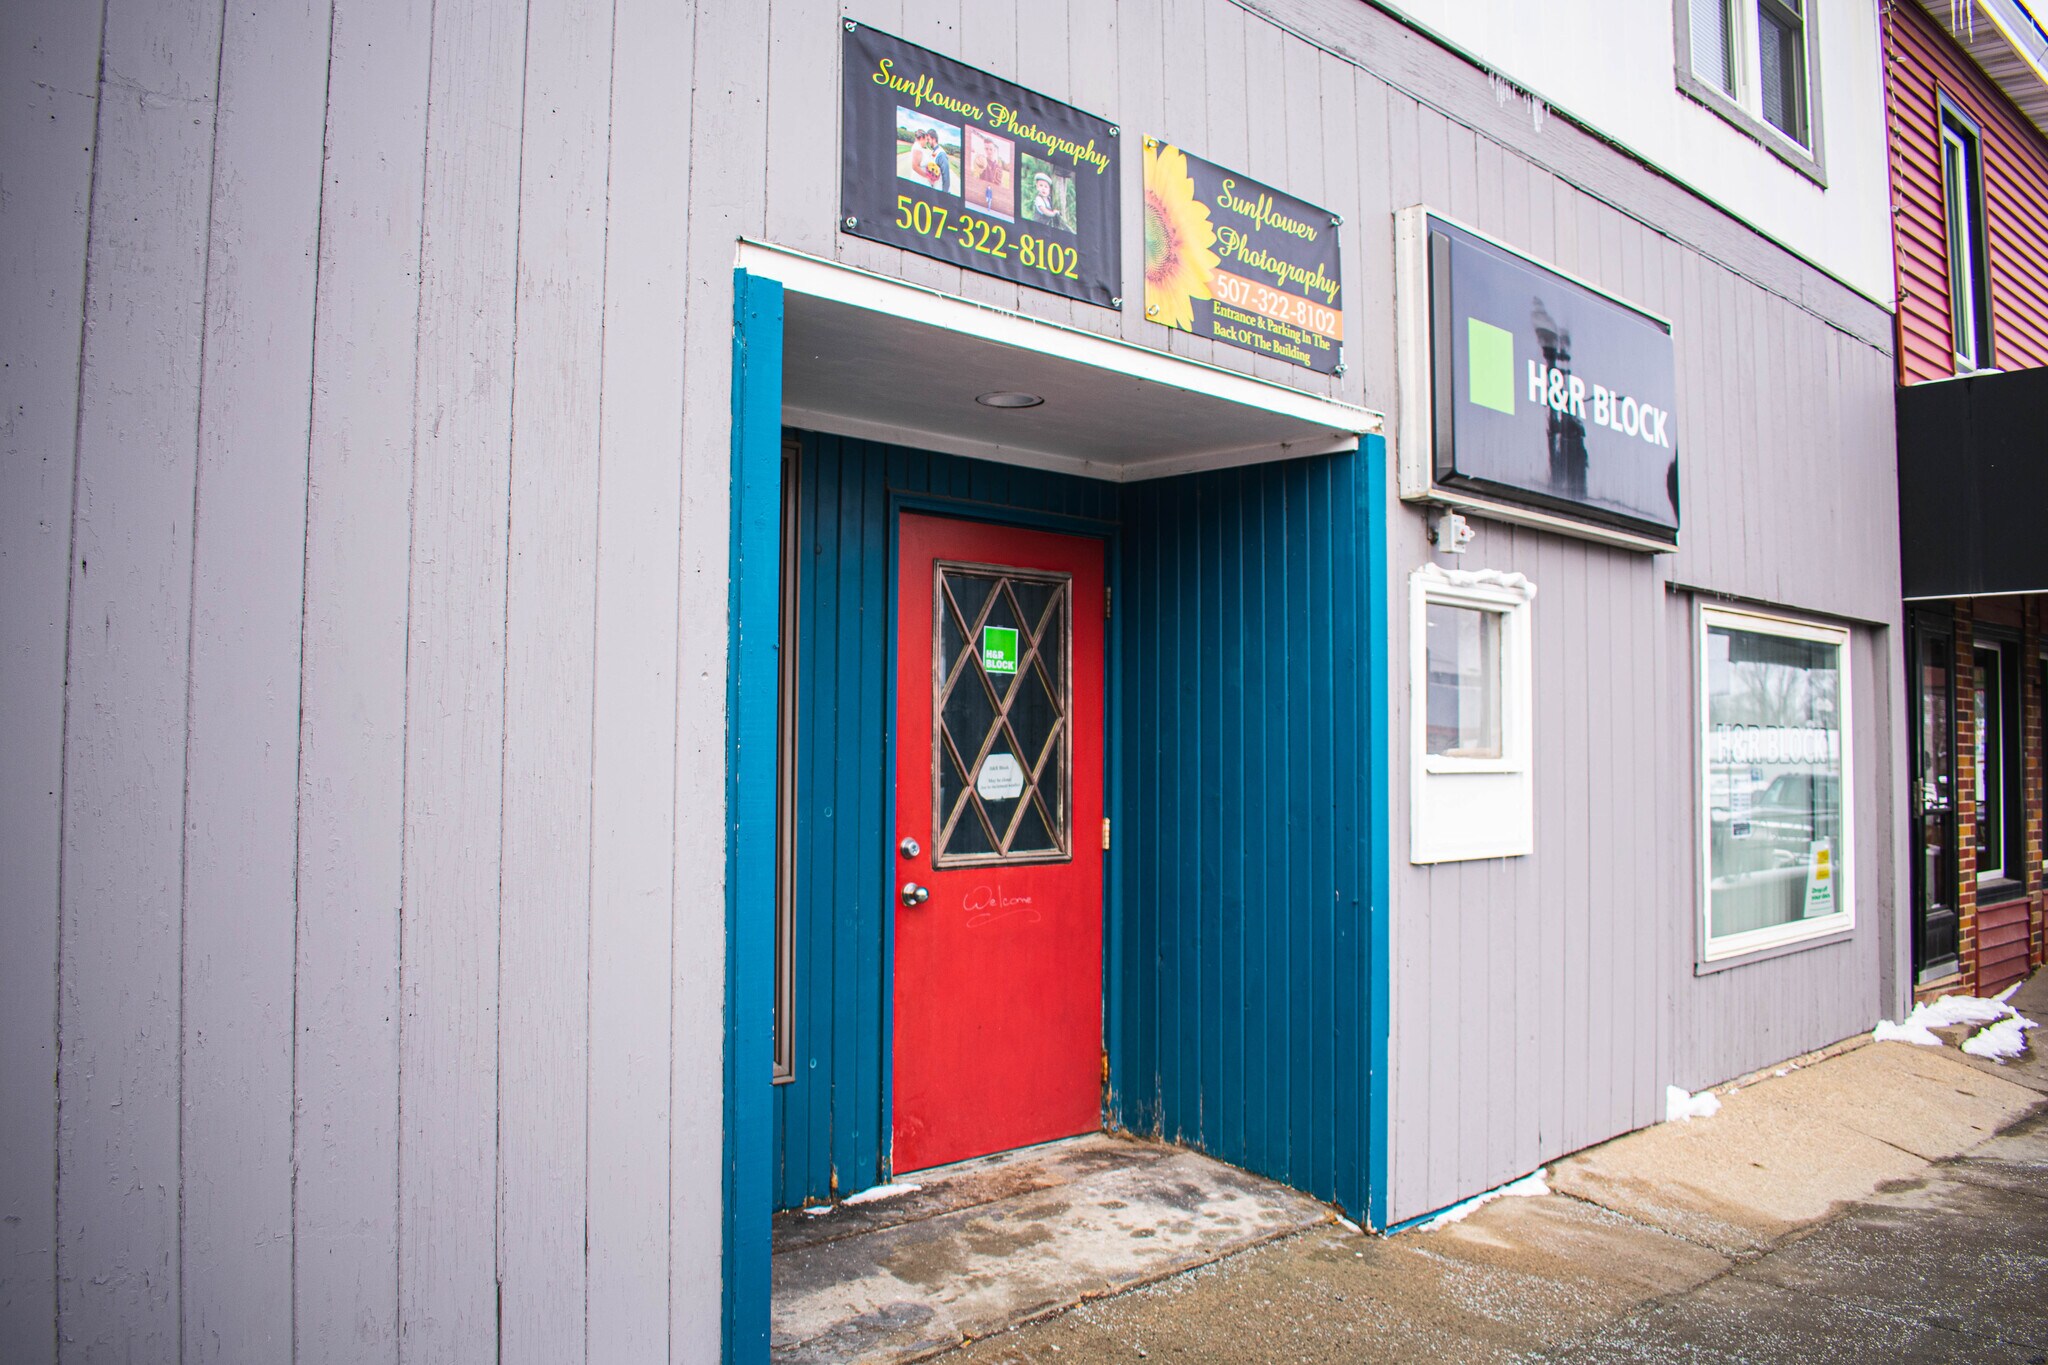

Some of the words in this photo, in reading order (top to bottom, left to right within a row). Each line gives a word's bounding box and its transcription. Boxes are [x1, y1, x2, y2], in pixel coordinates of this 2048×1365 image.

[872, 58, 983, 121] Sunflower
[987, 102, 1110, 175] Photography
[895, 195, 1079, 280] 507-322-8102
[1217, 178, 1317, 242] Sunflower
[1217, 226, 1340, 304] Photography
[1213, 300, 1256, 327] Entrance
[1257, 316, 1266, 330] &
[1267, 318, 1301, 344] Parking
[1302, 330, 1312, 345] In
[1312, 333, 1331, 350] The
[1217, 274, 1335, 335] 507-322-8102
[1213, 321, 1237, 341] Back
[1238, 329, 1252, 345] Of
[1252, 333, 1271, 351] The
[1273, 340, 1311, 367] Building
[1527, 359, 1586, 419] H&R
[1593, 384, 1670, 449] BLOCK
[986, 649, 1004, 660] H&R
[986, 659, 1014, 670] BLOCK
[1716, 723, 1763, 764] H&R
[1766, 725, 1828, 765] BLOCK
[963, 885, 1032, 911] Welcome
